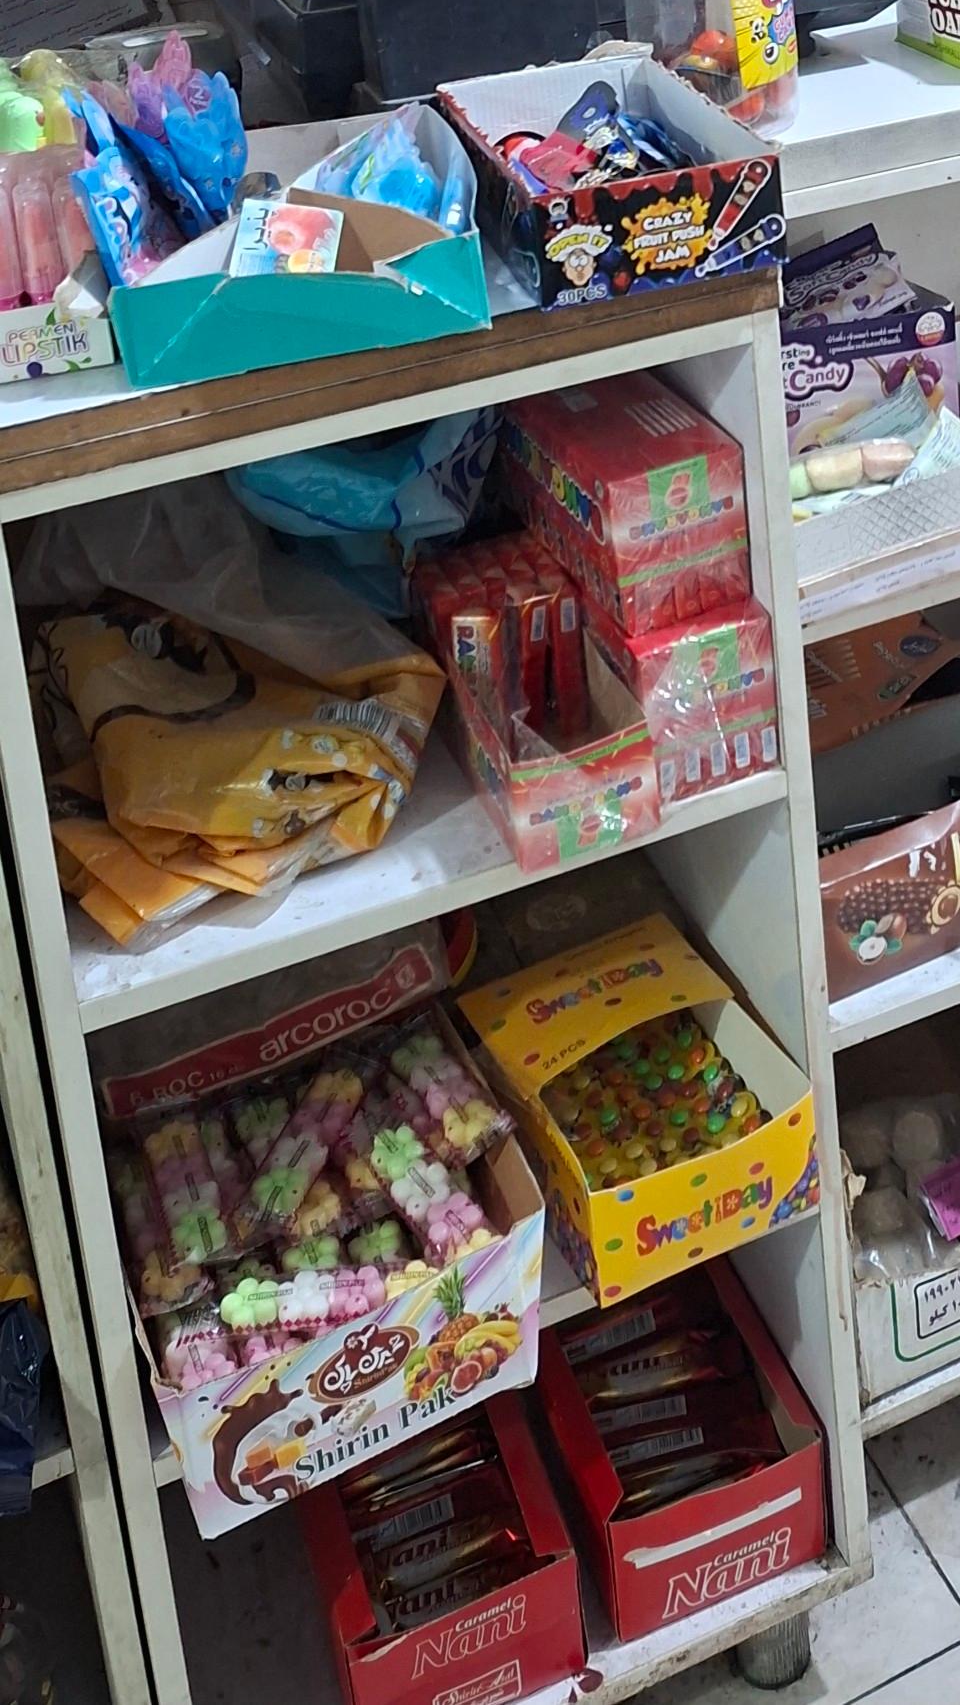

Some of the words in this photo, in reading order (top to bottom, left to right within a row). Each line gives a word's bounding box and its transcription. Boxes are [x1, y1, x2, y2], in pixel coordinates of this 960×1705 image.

[243, 208, 276, 251] پذیرا
[633, 230, 670, 250] FRUIT
[672, 224, 705, 243] PUSH
[643, 210, 692, 232] CRAZY
[548, 232, 590, 259] OPEN
[655, 244, 690, 264] JAM
[557, 286, 607, 305] 30PCS
[2, 330, 90, 367] LIPSTIK
[8, 321, 76, 345] PERMEN
[789, 367, 845, 392] Candy
[526, 977, 602, 1025] Sweet
[259, 987, 398, 1064] arcoroc
[541, 1054, 559, 1070] 24
[560, 1038, 587, 1059] PCS
[636, 1202, 713, 1257] Sweet
[928, 1304, 952, 1327] کیلو
[297, 1420, 392, 1482] Shirin
[399, 1385, 458, 1430] Pak
[713, 1529, 775, 1566] Caramel
[662, 1527, 792, 1620] Nani
[454, 1596, 513, 1633] Caramel
[411, 1594, 527, 1680] Nani
